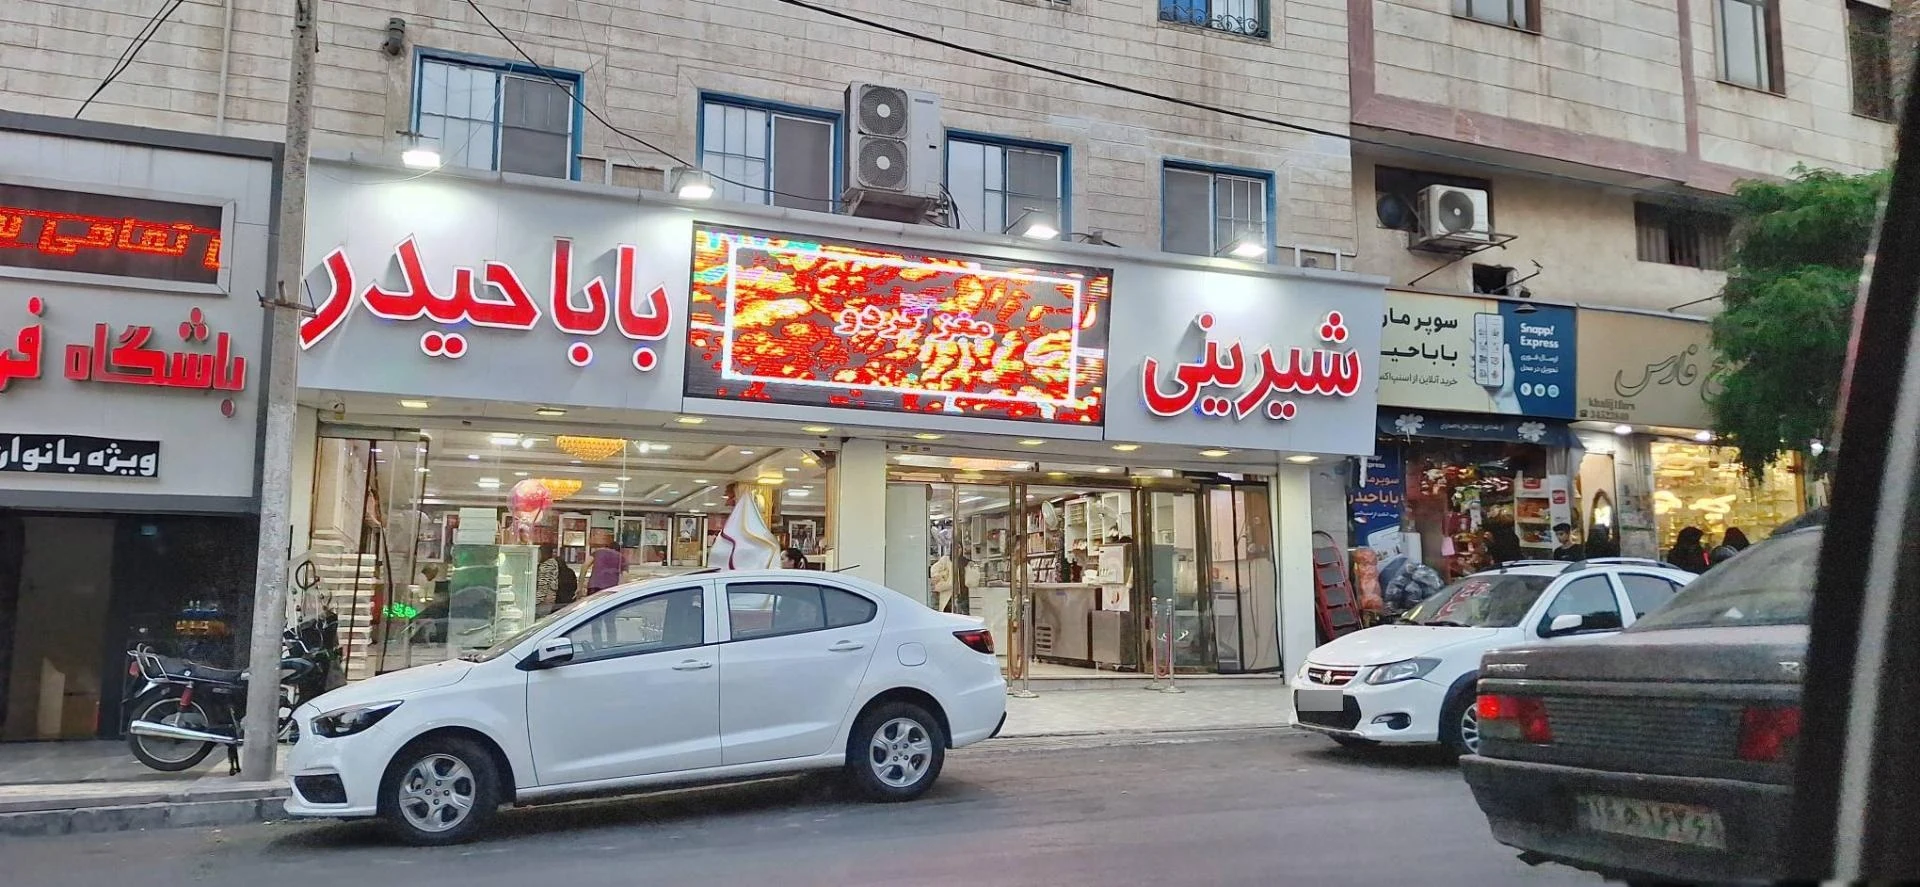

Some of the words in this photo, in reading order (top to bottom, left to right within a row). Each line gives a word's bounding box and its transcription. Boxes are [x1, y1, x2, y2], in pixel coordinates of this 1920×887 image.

[1520, 322, 1555, 337] Snapp!
[1520, 336, 1560, 350] Express
[63, 306, 247, 418] باشگاه
[1141, 309, 1363, 421] شیرینی
[1614, 343, 1699, 398] فارس
[87, 442, 158, 477] ویژه
